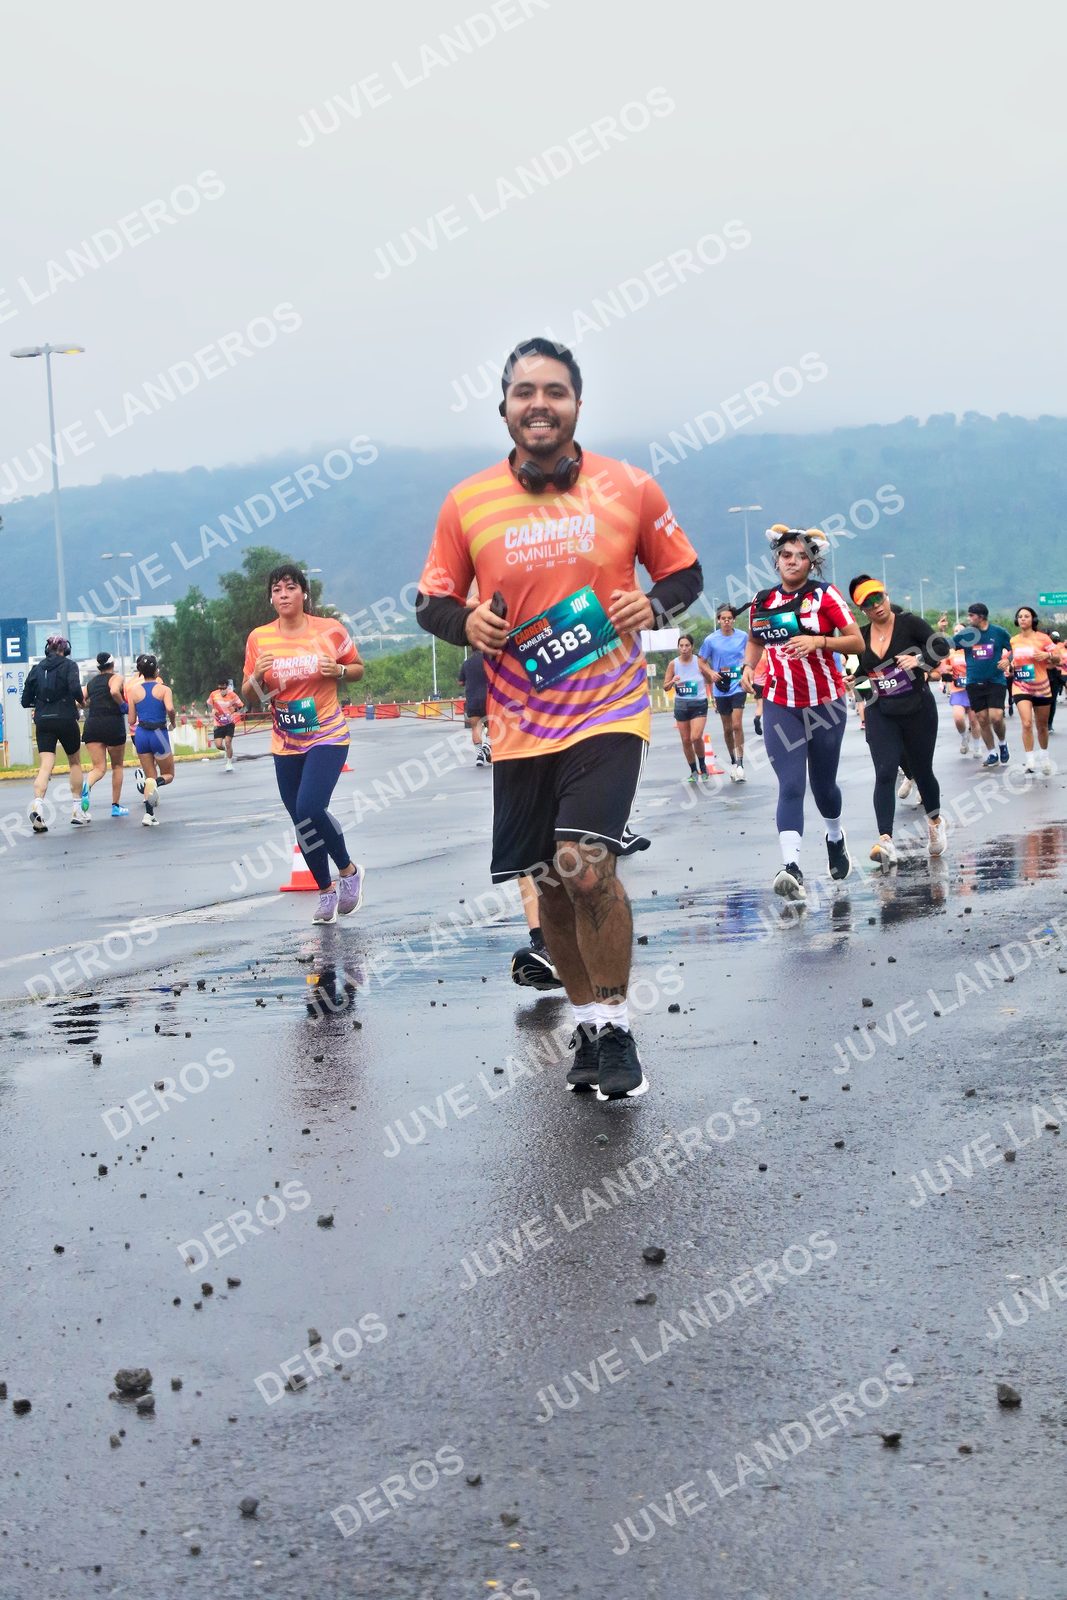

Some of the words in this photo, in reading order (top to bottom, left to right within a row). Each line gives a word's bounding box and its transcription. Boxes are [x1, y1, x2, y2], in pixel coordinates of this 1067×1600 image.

[505, 514, 595, 549] CARRERA
[506, 541, 576, 565] OMNILIFE
[570, 593, 590, 614] 10K
[514, 617, 550, 645] CARRERA
[760, 628, 789, 640] 1430
[6, 637, 21, 657] E
[537, 623, 592, 664] 1383
[272, 655, 318, 670] CARRERA
[879, 679, 898, 689] 599
[280, 713, 305, 724] 1614
